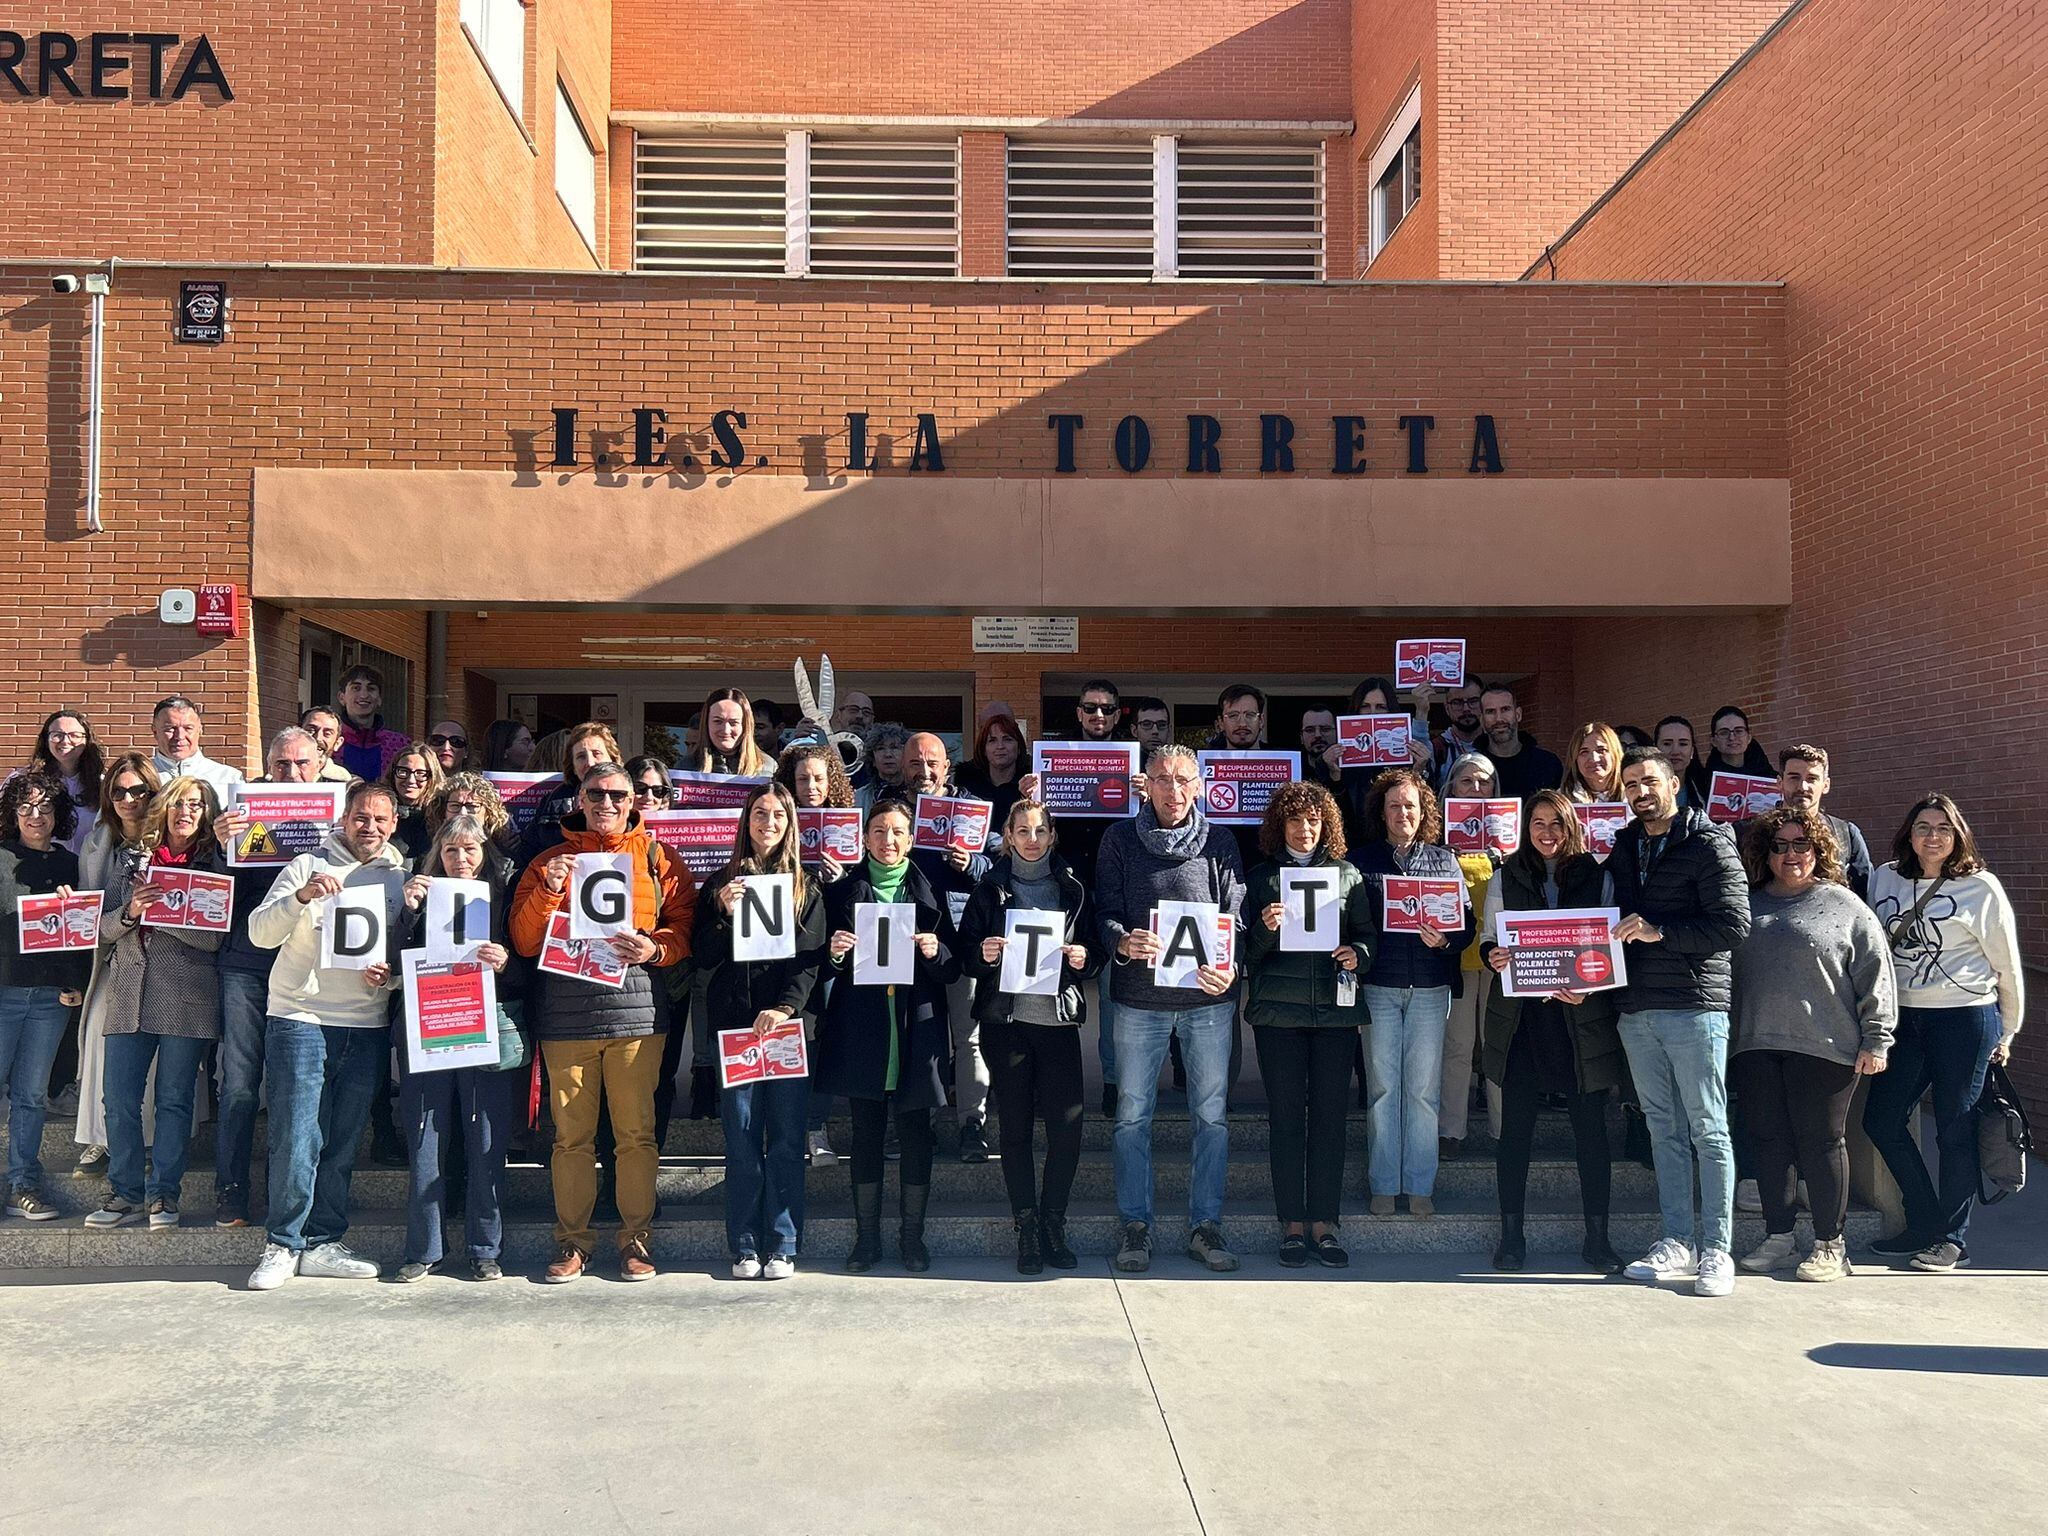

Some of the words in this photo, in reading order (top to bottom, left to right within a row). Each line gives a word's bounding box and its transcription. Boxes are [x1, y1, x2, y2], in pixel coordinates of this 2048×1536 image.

[551, 408, 768, 467] I.E.S.
[846, 413, 946, 472] LA
[1048, 415, 1505, 473] TORRETA
[200, 586, 231, 594] FUEGO
[1043, 760, 1050, 769] 7
[1206, 767, 1213, 776] 2
[1064, 777, 1099, 785] DOCENTS,
[251, 799, 333, 808] INFRAESTRUCTURES
[683, 795, 711, 803] DIGNES
[239, 805, 247, 816] 5
[251, 809, 282, 817] DIGNES
[658, 826, 689, 834] BAIXAR
[706, 824, 738, 833] RÀTIOS,
[282, 838, 318, 846] EDUCACIÓ
[659, 834, 702, 843] ENSENYAR
[580, 869, 627, 924] G
[1290, 880, 1329, 933] T
[740, 885, 784, 939] N
[452, 892, 466, 946] I
[333, 906, 380, 956] D
[1521, 928, 1571, 937] PROFESSORAT
[1571, 927, 1599, 935] EXPERT
[876, 916, 891, 967] I
[1162, 915, 1209, 968] A
[1509, 933, 1517, 943] 7
[1014, 924, 1053, 978] T
[1514, 951, 1534, 959] SOM
[1535, 950, 1576, 959] DOCENTS,
[1515, 959, 1544, 968] VOLEM
[1545, 959, 1560, 967] LES
[416, 967, 448, 975] NOVIEMBRE
[1516, 968, 1558, 977] MATEIXES
[1517, 976, 1570, 986] CONDICIONS
